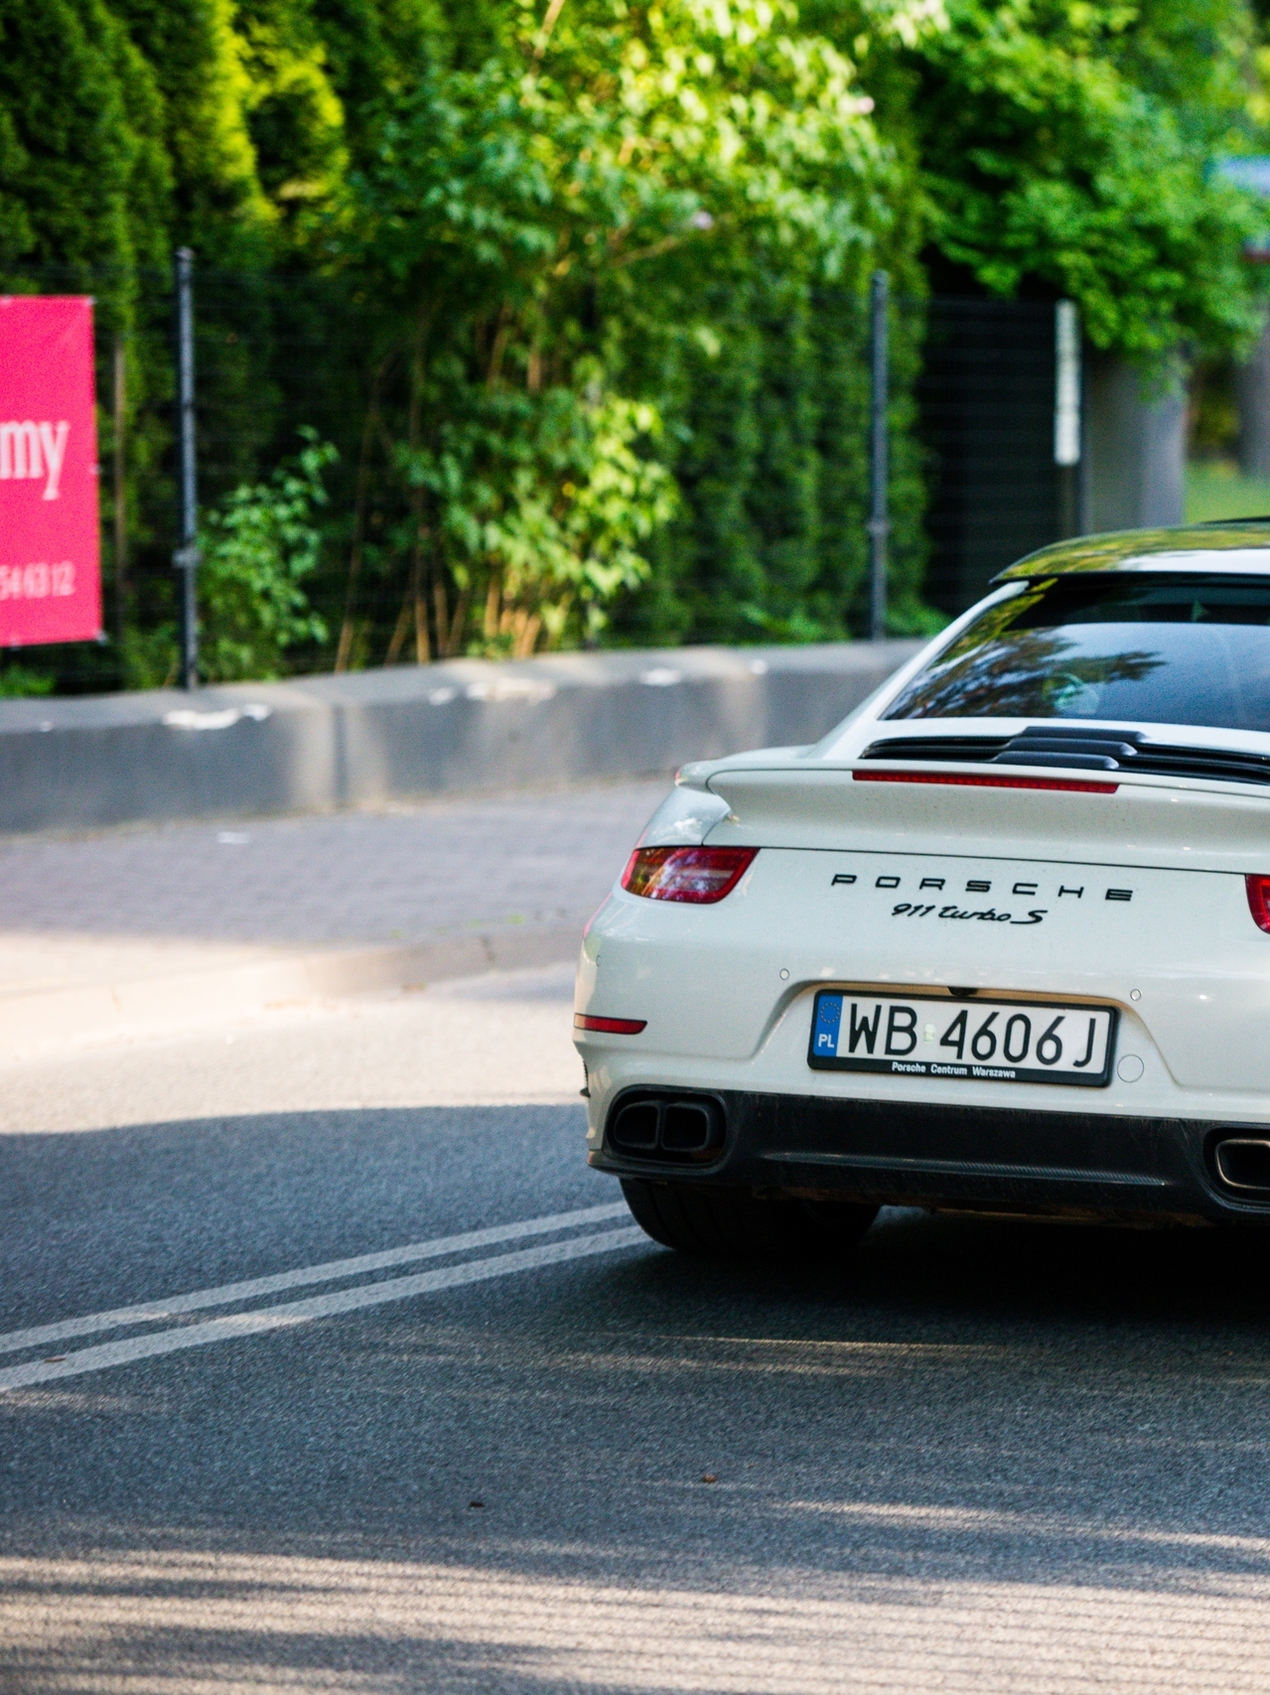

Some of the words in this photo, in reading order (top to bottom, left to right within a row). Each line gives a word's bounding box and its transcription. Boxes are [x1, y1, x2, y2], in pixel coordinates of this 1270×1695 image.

[831, 874, 1133, 901] PORSCHE
[891, 903, 936, 917] 911
[938, 905, 1012, 922] turbo
[1010, 909, 1048, 924] S
[818, 1033, 835, 1049] PL
[848, 1003, 918, 1056] WB
[940, 1009, 1097, 1068] 4606J
[892, 1061, 926, 1075] Porsche
[930, 1064, 968, 1077] Centrum
[972, 1066, 1016, 1079] Warszawa
